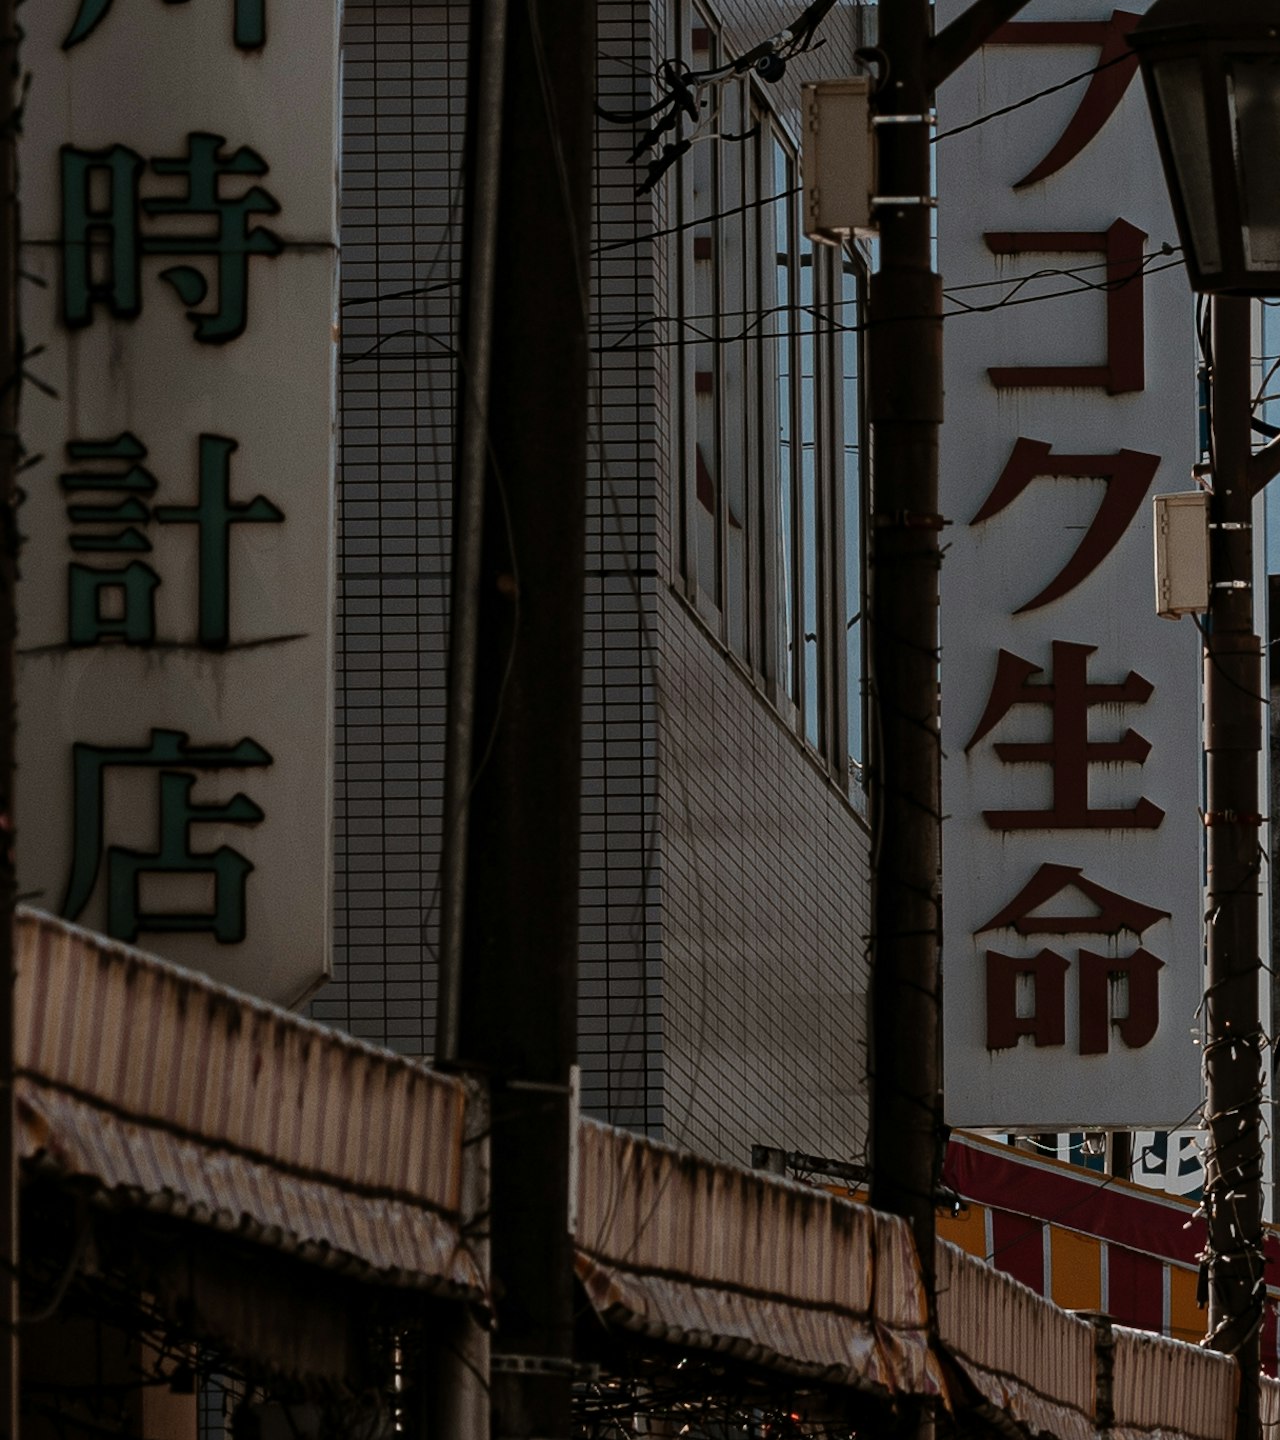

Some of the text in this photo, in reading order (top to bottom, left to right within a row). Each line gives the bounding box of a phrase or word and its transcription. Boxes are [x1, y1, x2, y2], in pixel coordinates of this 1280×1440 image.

[965, 9, 1172, 1055] フコク生命
